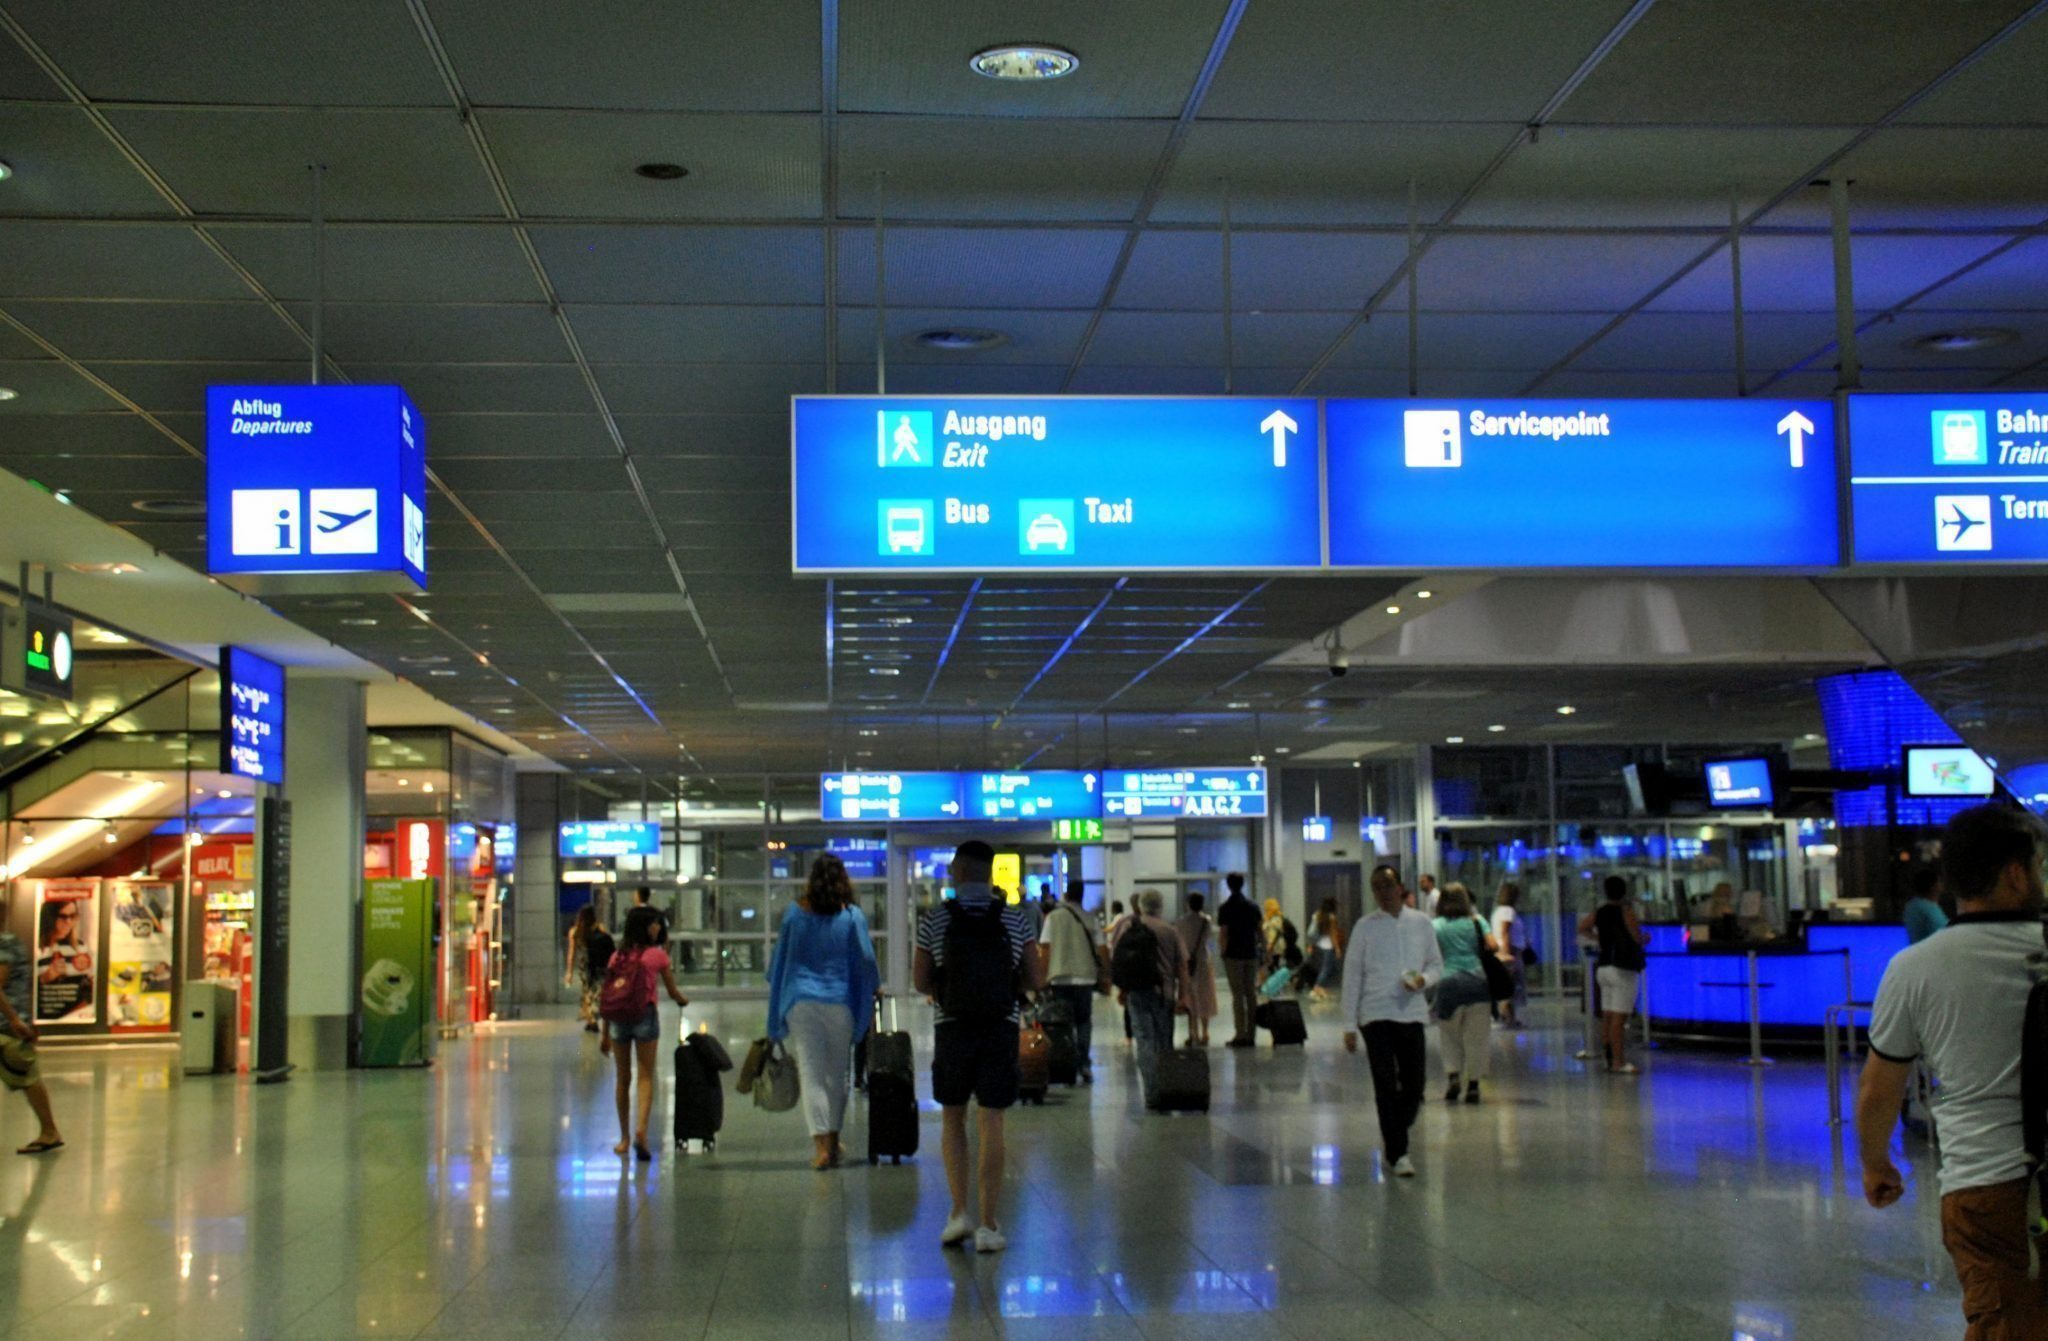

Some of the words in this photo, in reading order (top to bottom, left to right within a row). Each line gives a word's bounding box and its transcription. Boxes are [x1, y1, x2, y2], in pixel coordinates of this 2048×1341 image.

[231, 399, 282, 418] Abflug
[231, 418, 313, 436] Departures
[942, 410, 1047, 440] Ausgang
[1469, 410, 1610, 441] Servicepoint
[942, 442, 989, 467] Exit
[944, 498, 990, 524] Bus
[1084, 497, 1133, 524] Taxi
